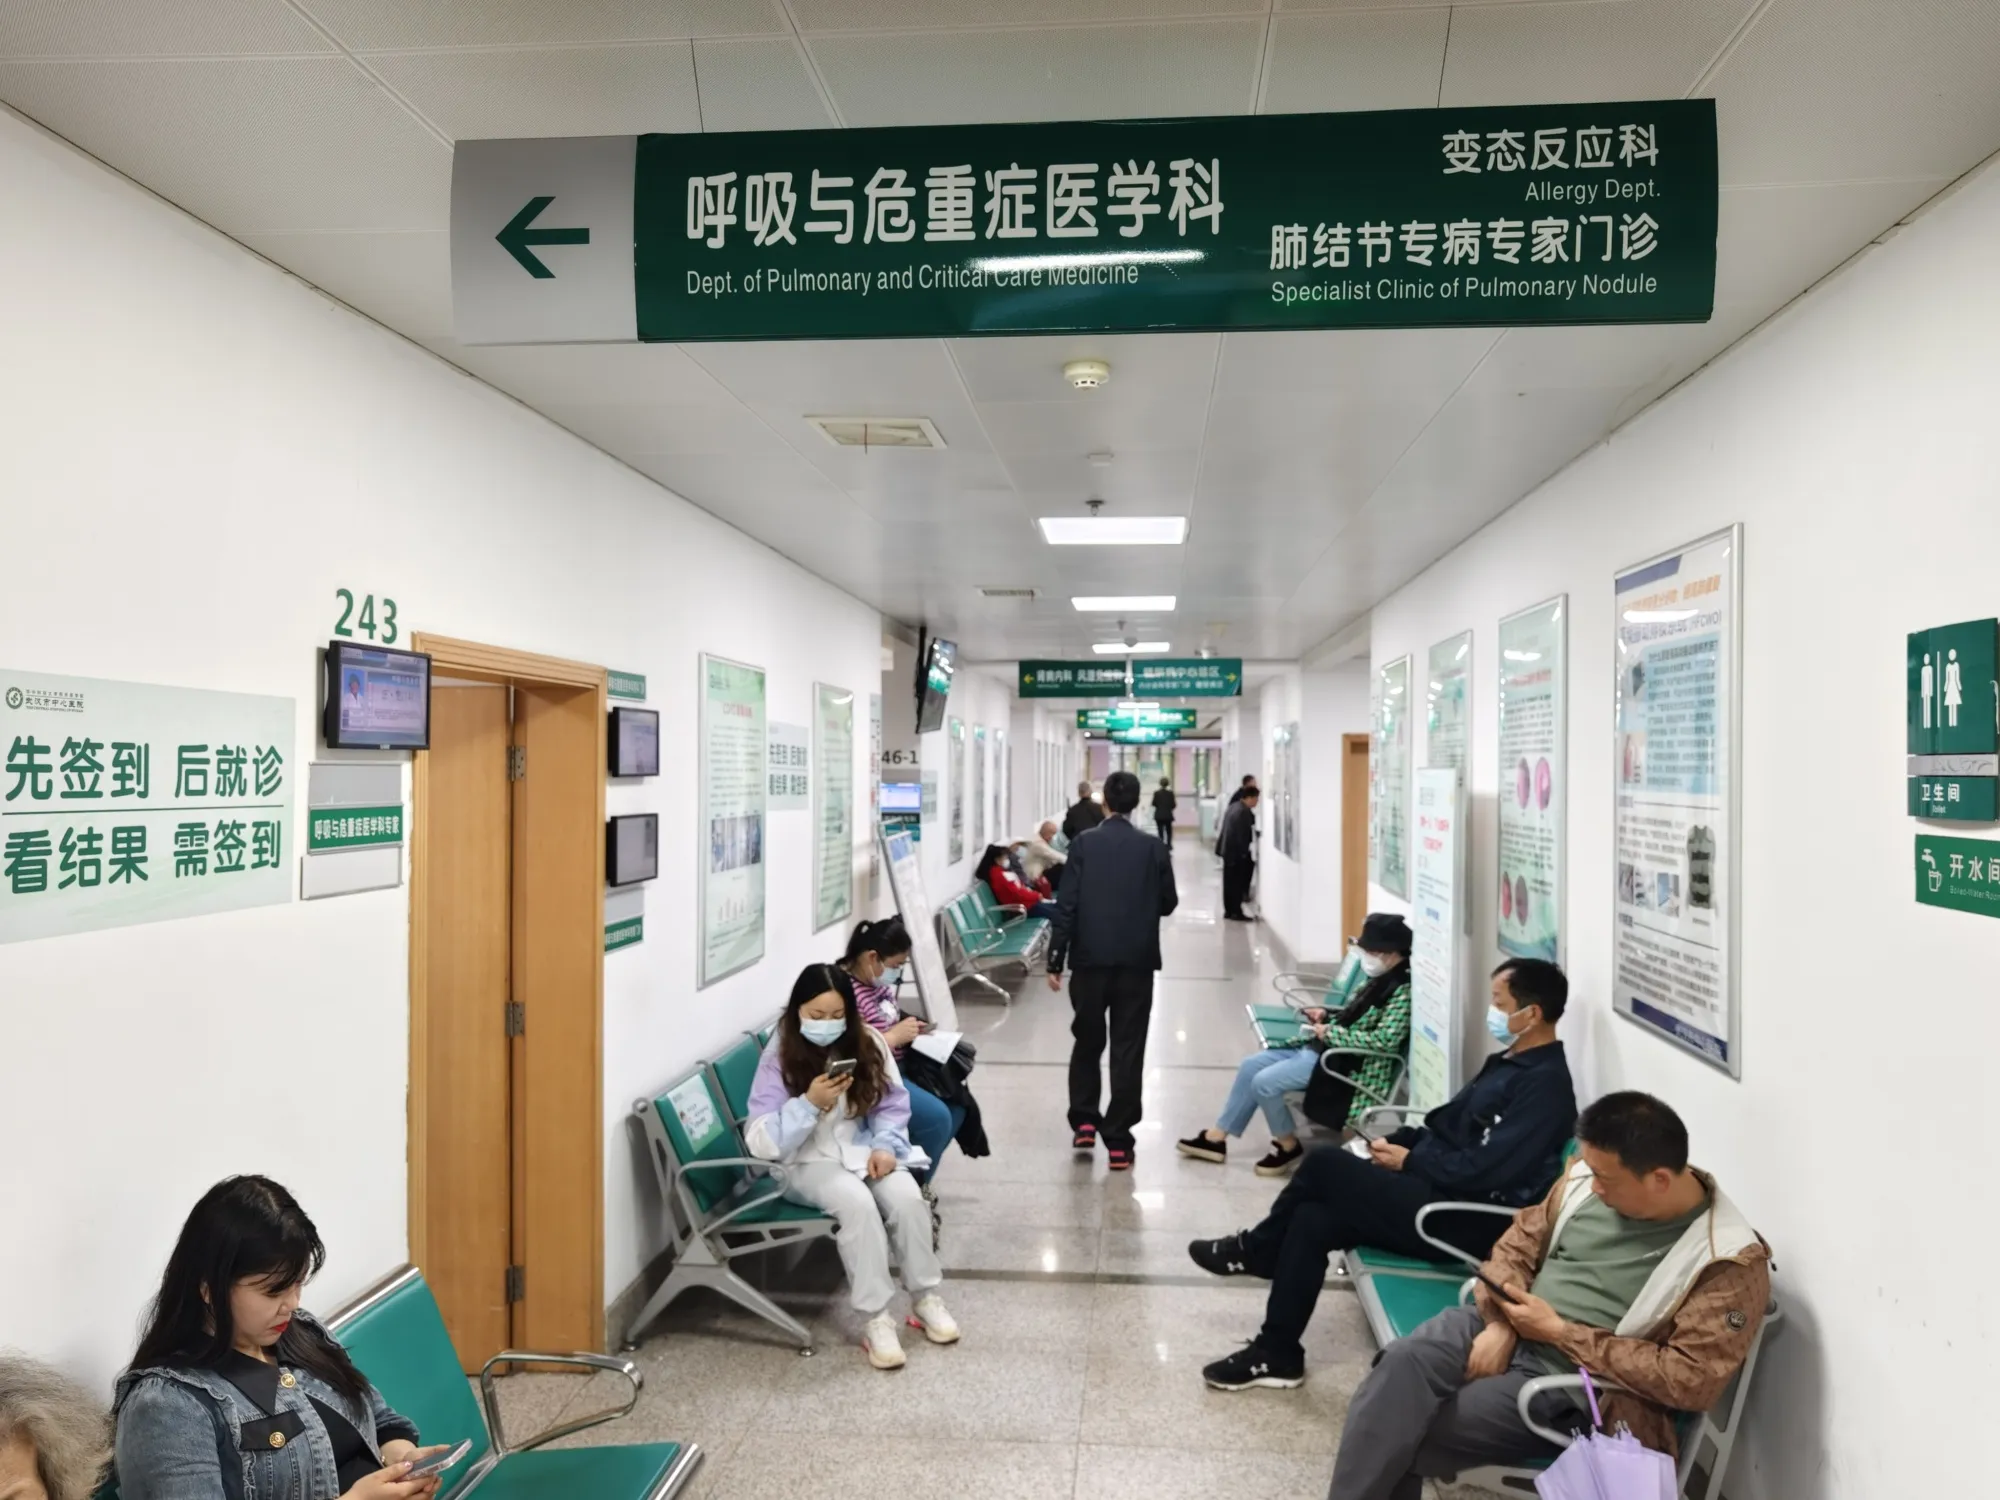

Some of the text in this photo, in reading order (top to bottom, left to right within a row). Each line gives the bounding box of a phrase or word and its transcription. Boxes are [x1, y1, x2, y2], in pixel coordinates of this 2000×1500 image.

[1442, 124, 1659, 174] 变态反应科
[687, 158, 1225, 249] 呼吸与危重症医学科
[1525, 179, 1661, 204] Allergy Dept.
[1270, 212, 1659, 270] 肺结节专病专家门诊
[687, 261, 1139, 298] Dept. of Pulmonary and Critical Care Medicine
[1271, 273, 1657, 305] Specialist Clinic of Pulmonary Nodule
[334, 588, 398, 644] 243
[5, 735, 283, 802] 先签到 后就诊
[1921, 783, 1960, 802] 卫生间
[314, 815, 400, 841] 呼吸与危重症医学科专家
[3, 819, 281, 895] 看结果 需签到
[1949, 853, 2000, 885] 开水间
